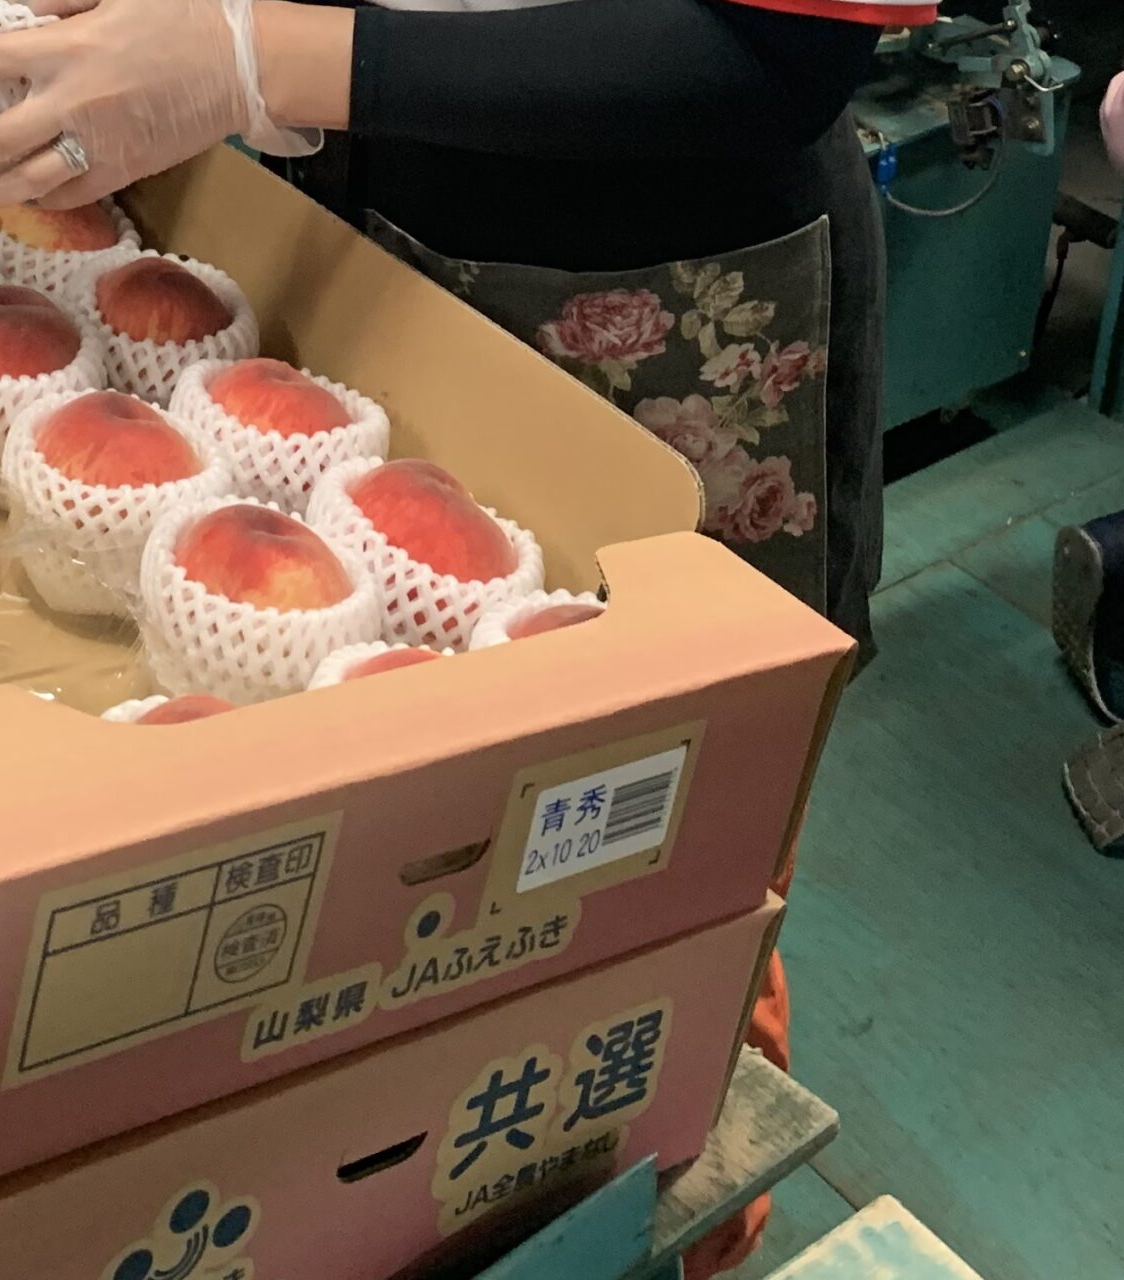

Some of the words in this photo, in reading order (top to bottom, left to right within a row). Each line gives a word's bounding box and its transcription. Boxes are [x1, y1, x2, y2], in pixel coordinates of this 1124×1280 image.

[540, 783, 607, 838] 青秀
[226, 843, 313, 894] 検査印
[576, 828, 601, 858] 20
[252, 981, 368, 1050] 山梨県
[390, 914, 568, 999] JAふえふき
[448, 1009, 664, 1181] 共選
